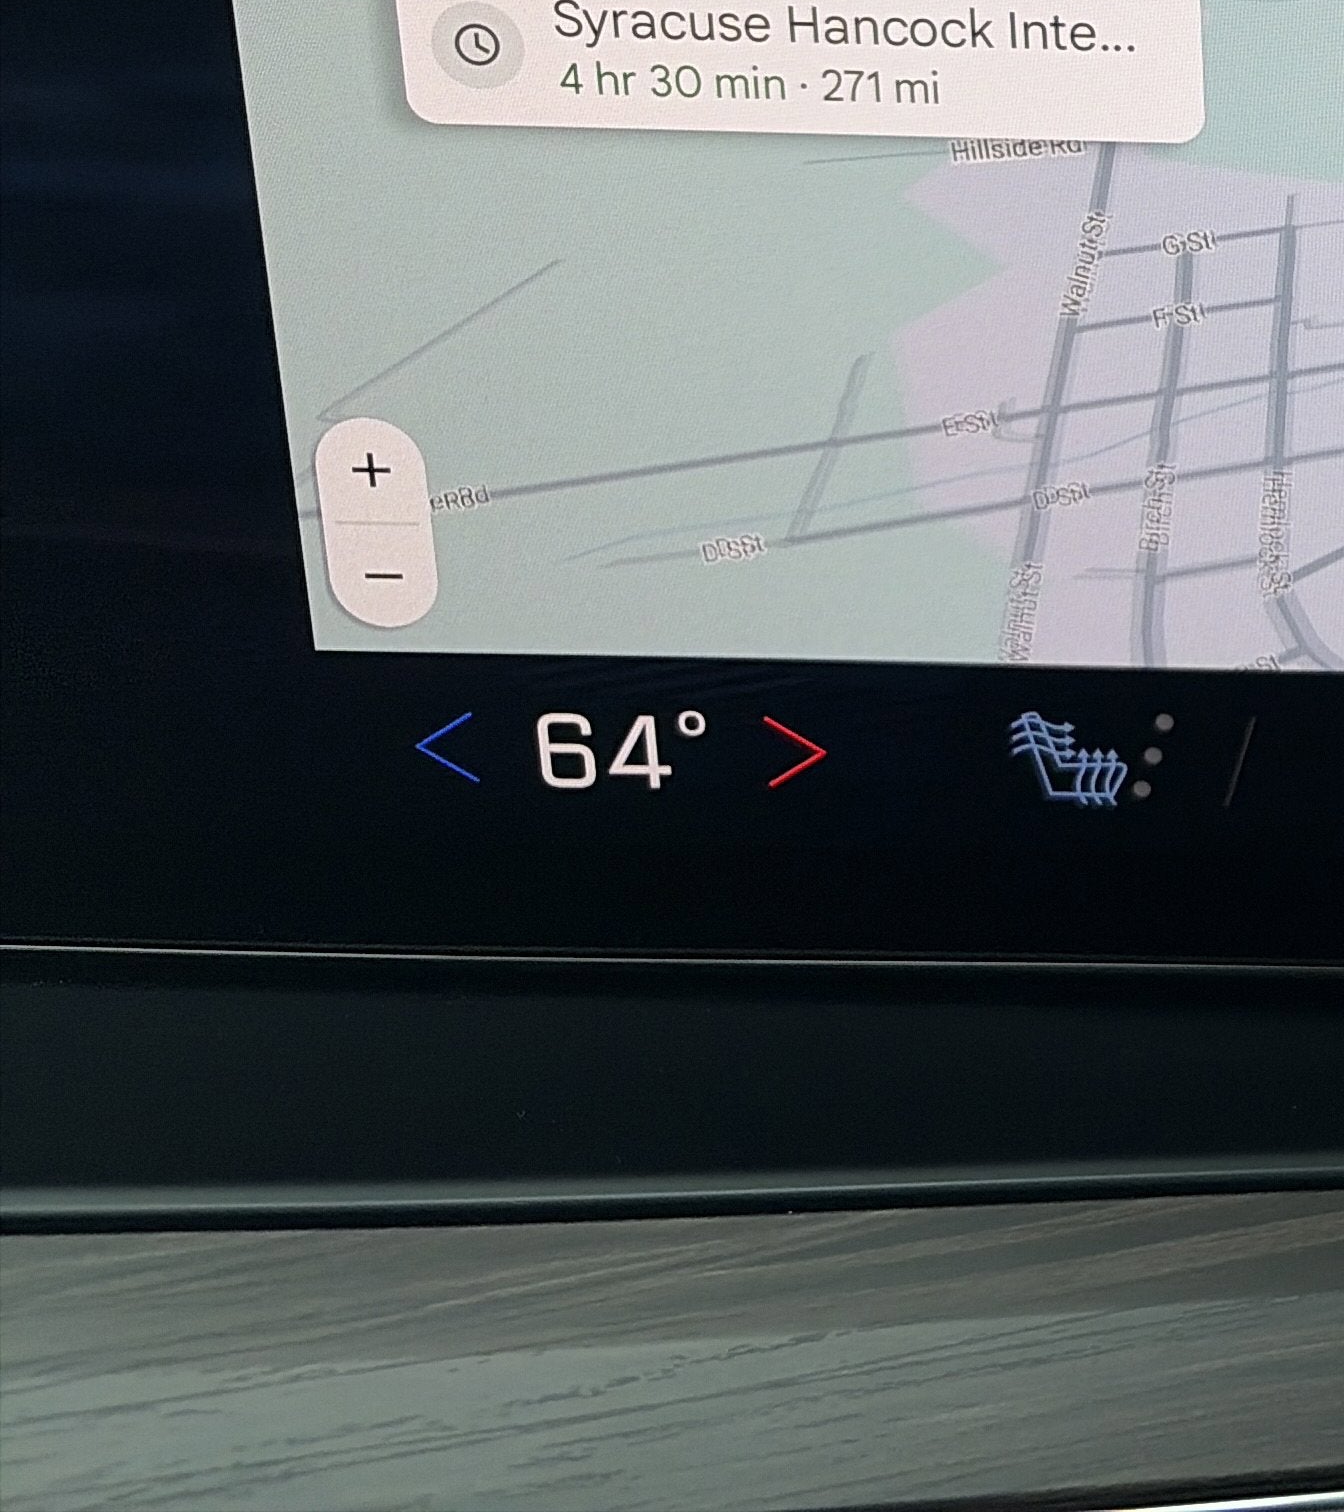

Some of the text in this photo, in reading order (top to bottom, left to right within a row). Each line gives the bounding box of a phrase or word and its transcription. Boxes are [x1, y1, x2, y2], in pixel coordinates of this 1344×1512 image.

[787, 3, 994, 50] Hancock
[1008, 12, 1137, 55] Inte...
[560, 62, 941, 104] 4 hr 30 min 271 mi
[951, 138, 1042, 163] Hillside
[535, 710, 707, 792] 64°
